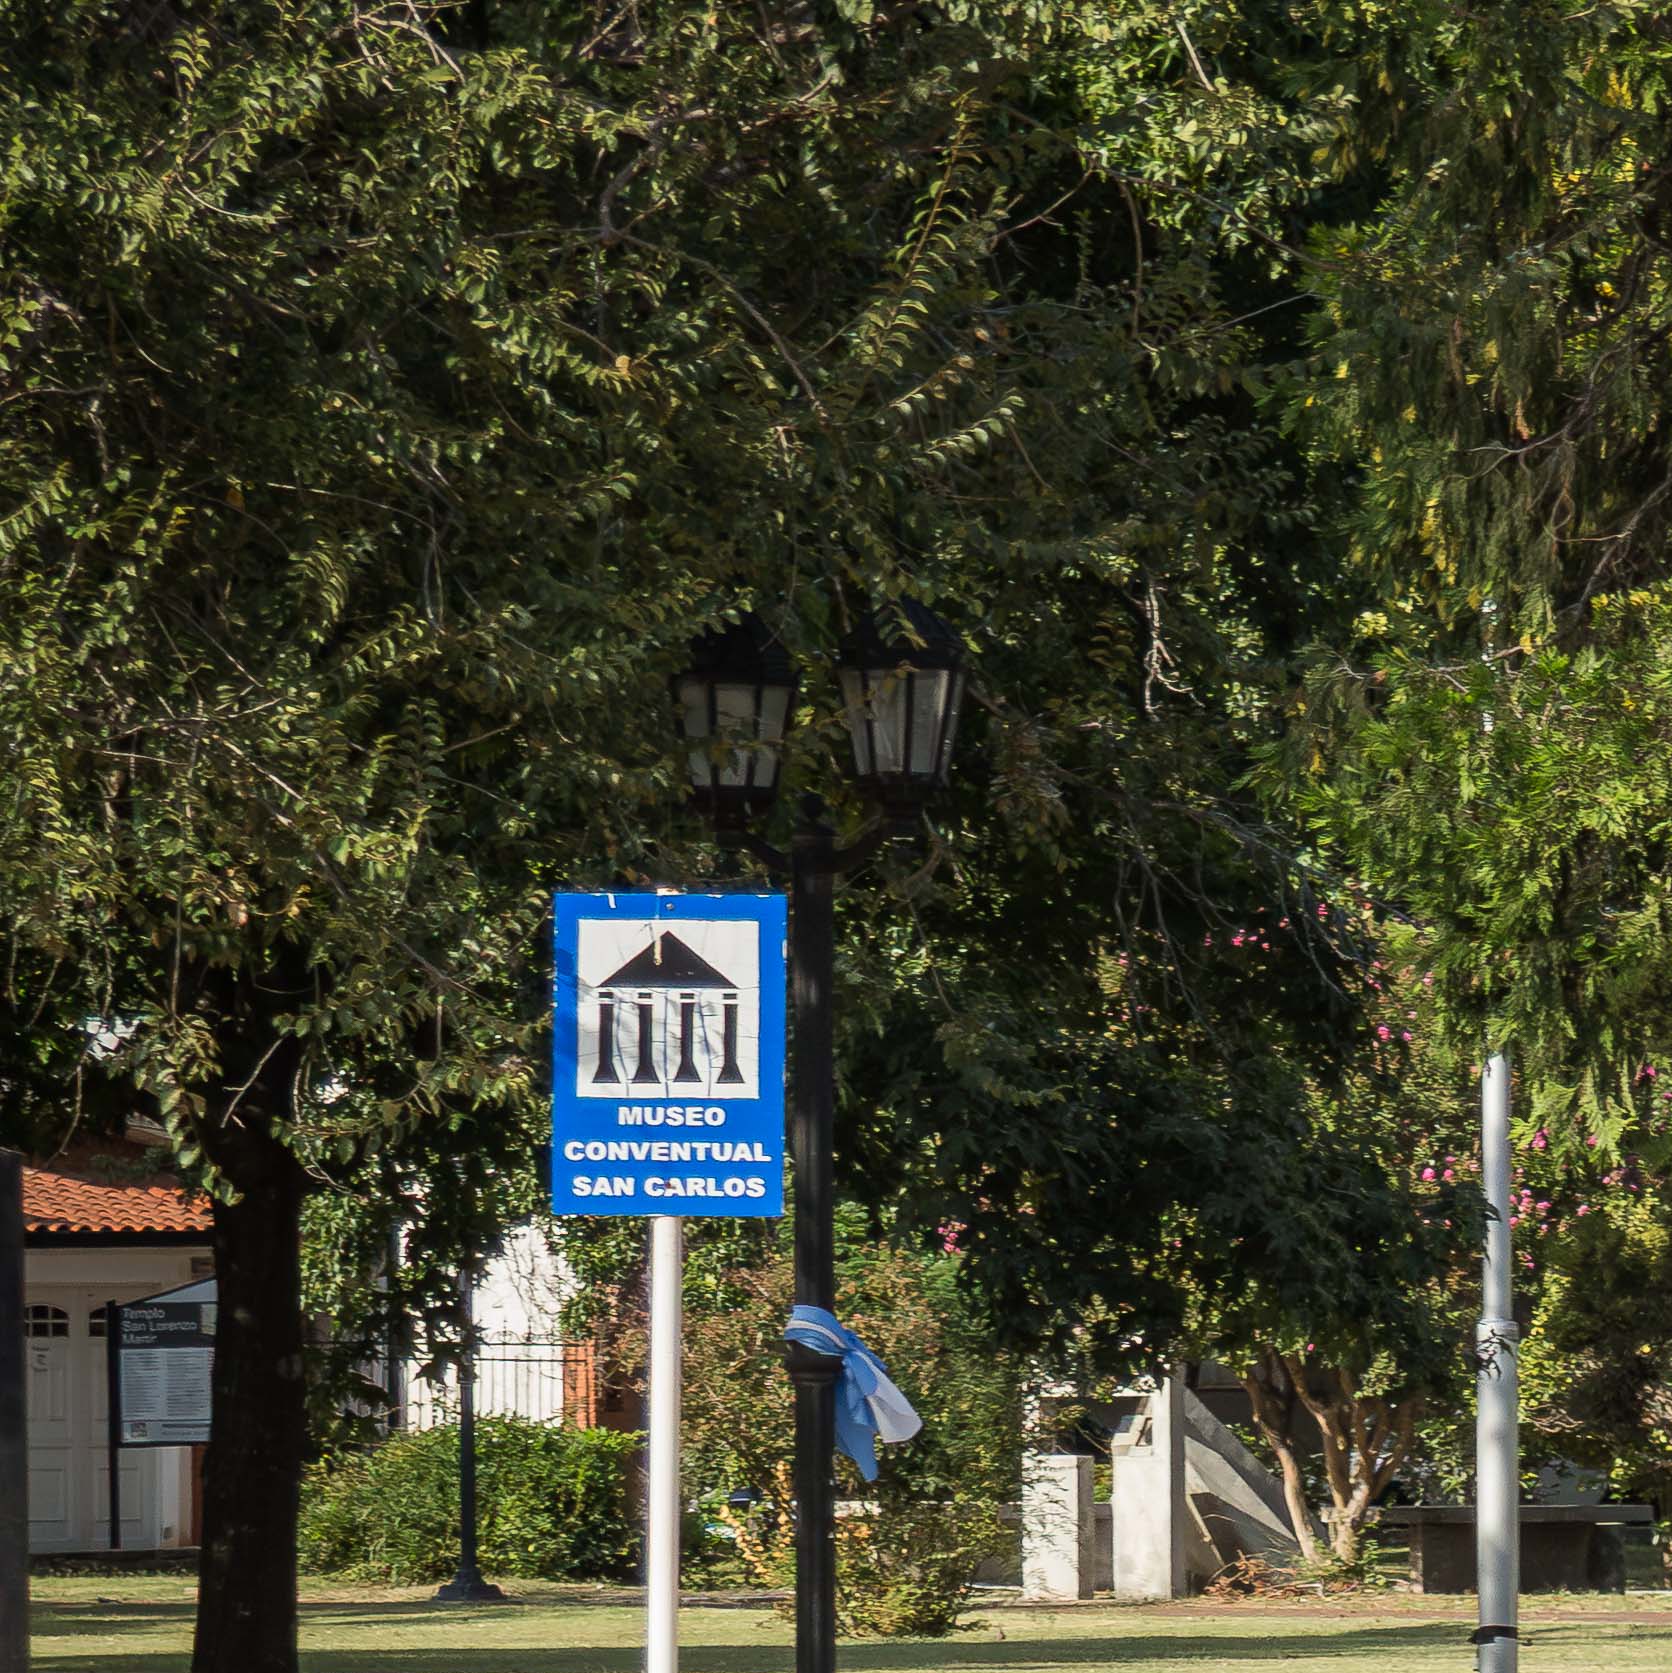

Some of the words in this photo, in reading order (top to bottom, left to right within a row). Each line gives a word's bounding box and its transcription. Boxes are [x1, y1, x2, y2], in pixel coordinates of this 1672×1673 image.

[618, 1106, 726, 1126] MUSEO
[564, 1141, 771, 1161] CONVENTUAL
[572, 1177, 635, 1196] SAN
[644, 1177, 766, 1197] CARLOS
[120, 1320, 147, 1332] San
[148, 1321, 198, 1332] Lorenzo
